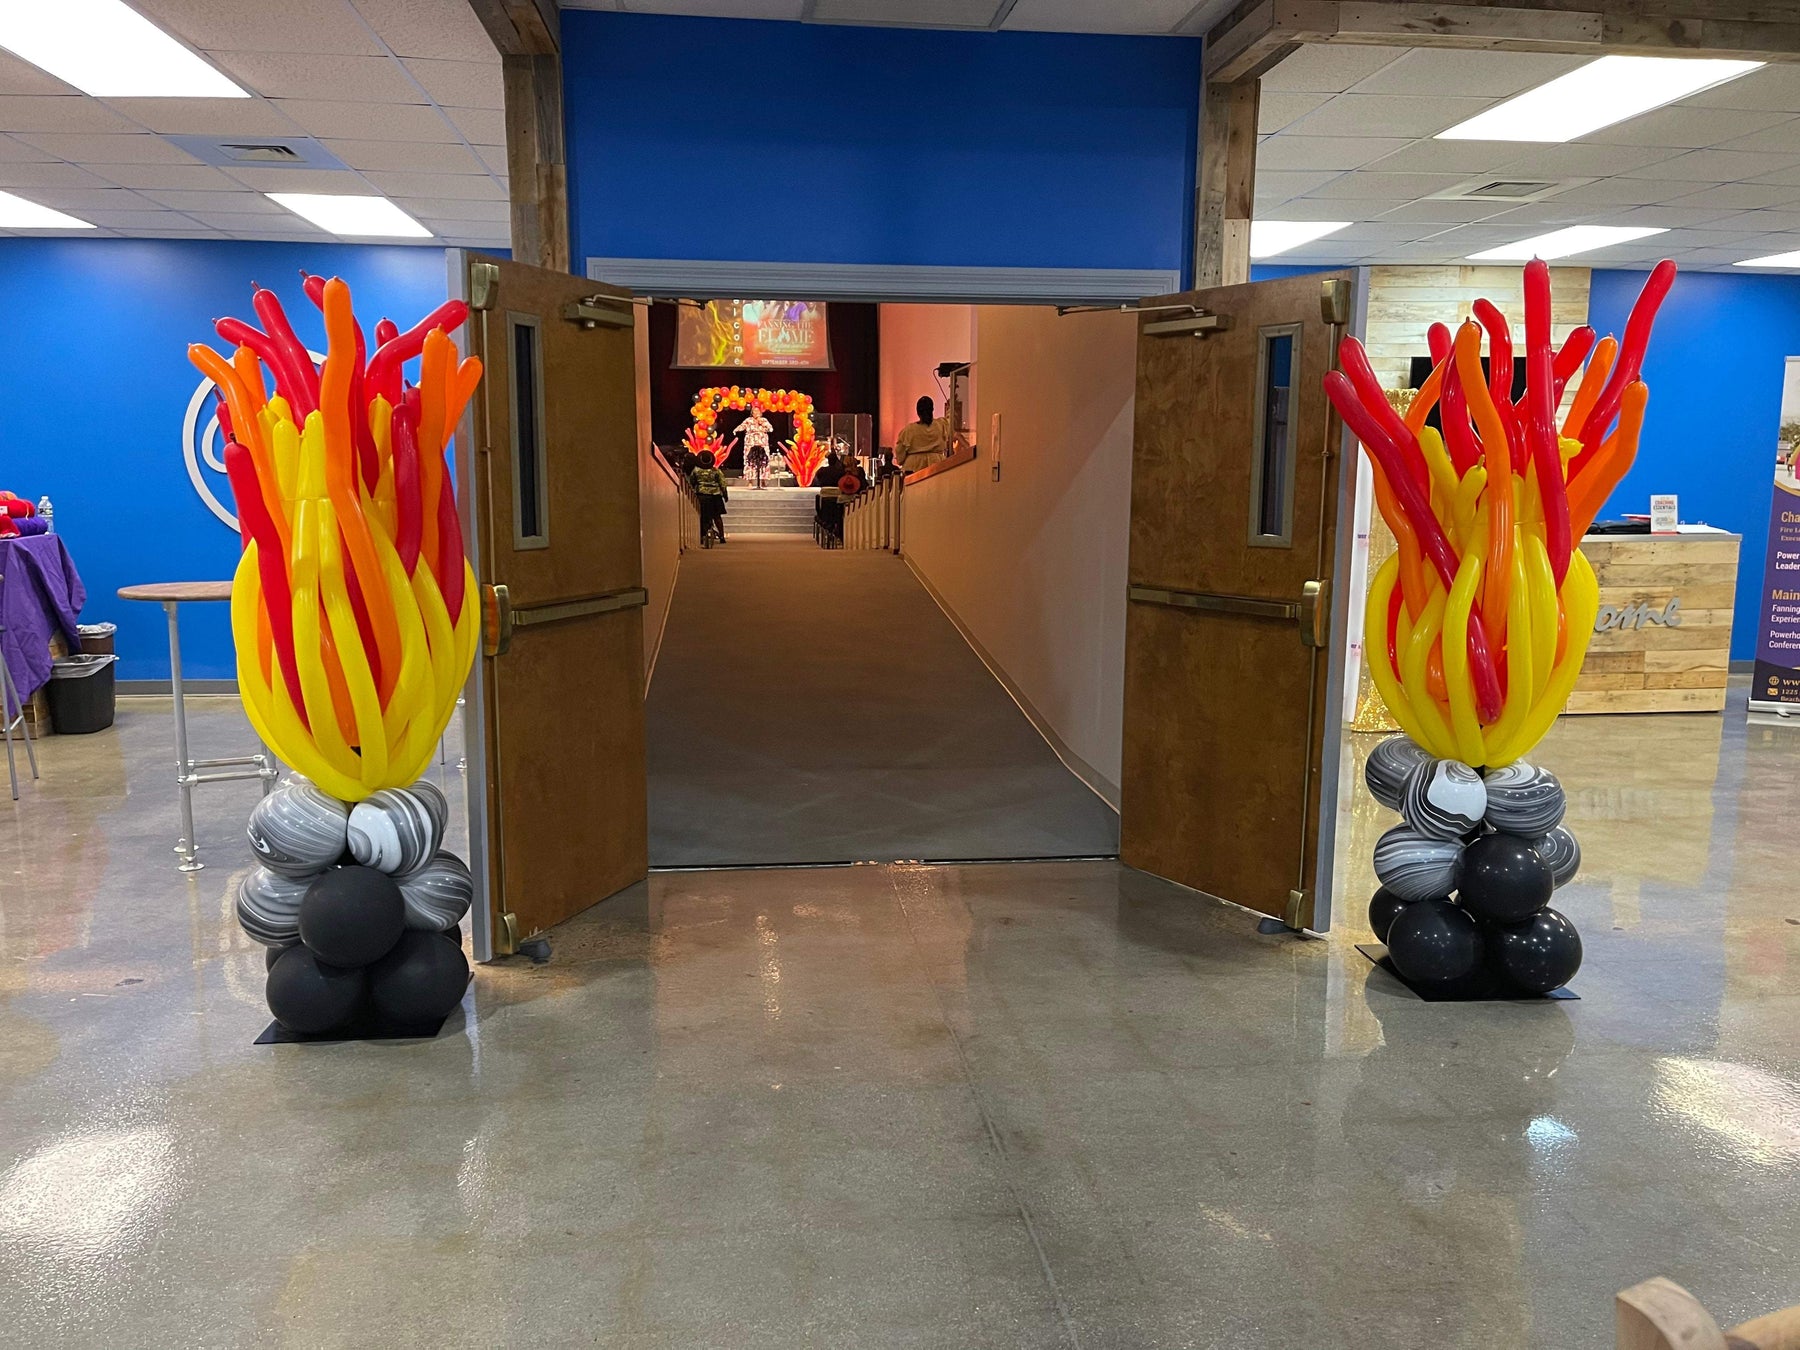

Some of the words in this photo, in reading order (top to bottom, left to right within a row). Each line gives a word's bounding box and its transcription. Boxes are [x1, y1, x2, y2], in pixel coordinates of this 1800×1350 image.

[1777, 551, 1800, 559] Power
[1775, 562, 1800, 570] Leader
[1772, 589, 1800, 600] Main
[1772, 604, 1800, 615] Fanning
